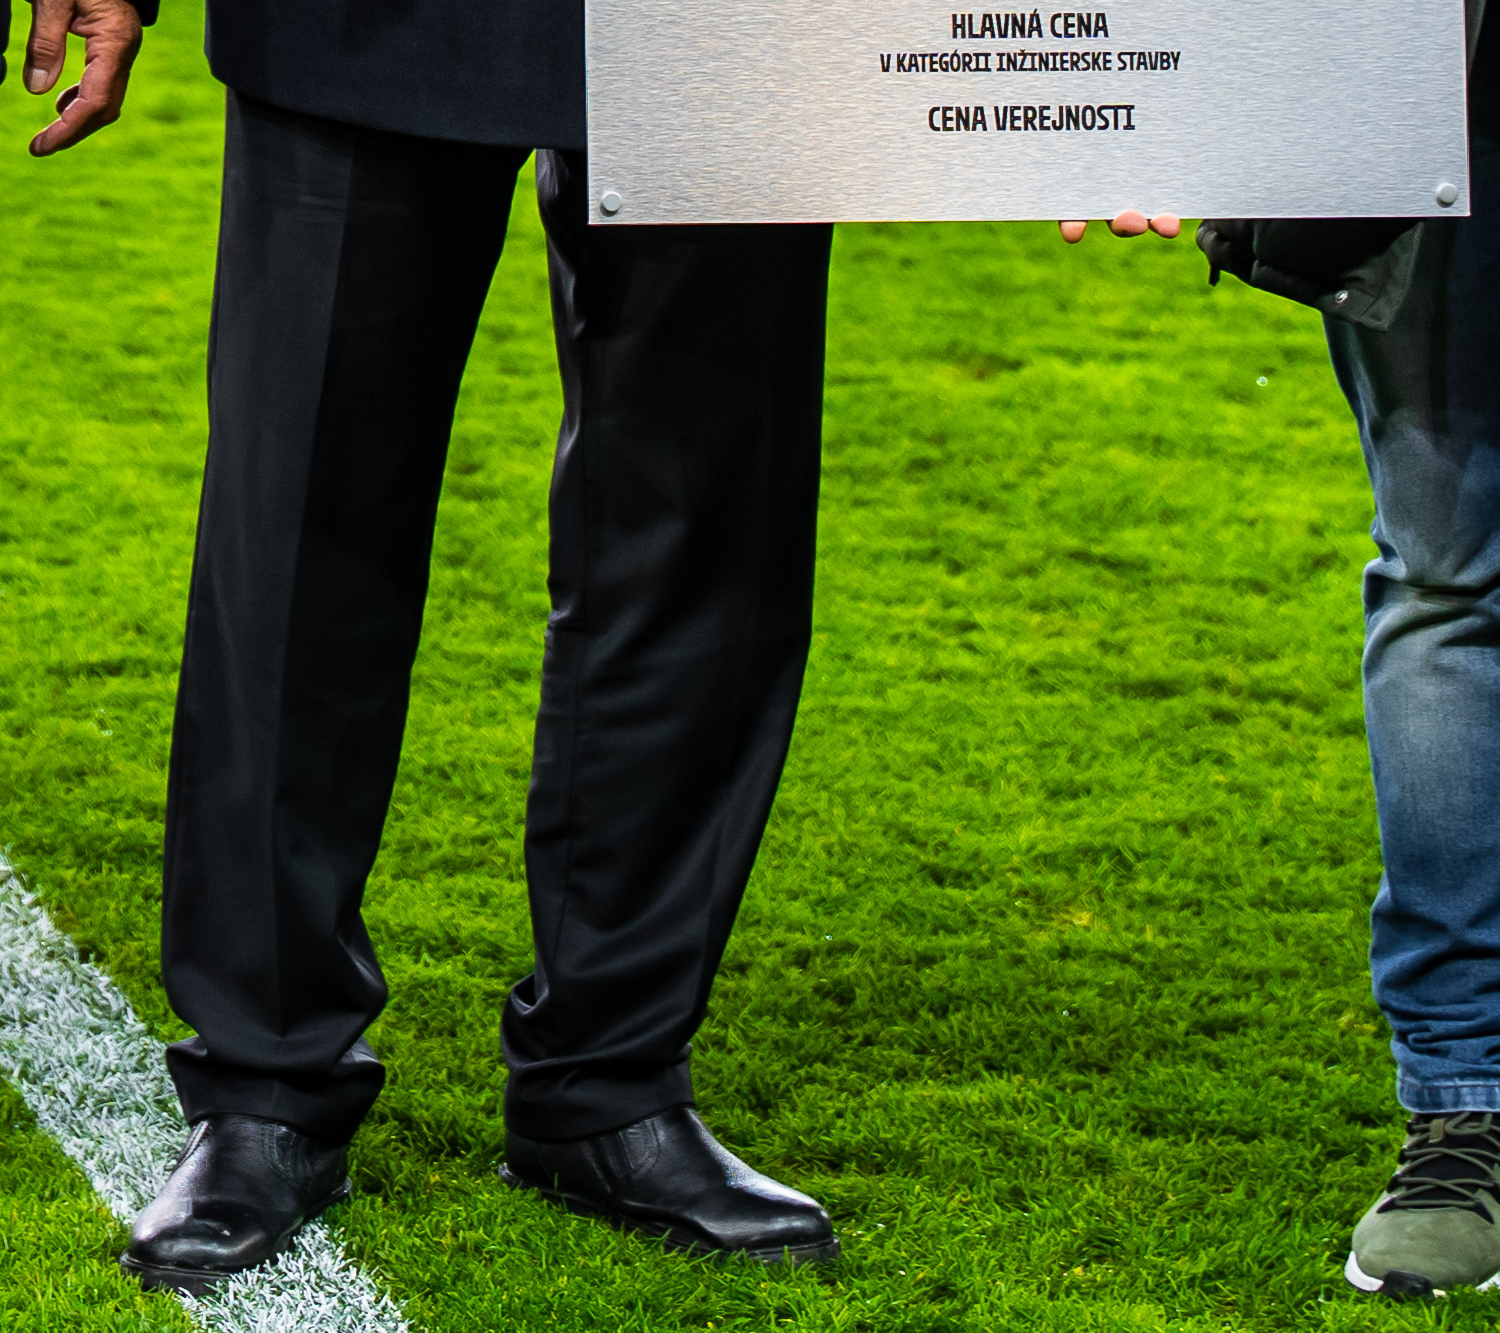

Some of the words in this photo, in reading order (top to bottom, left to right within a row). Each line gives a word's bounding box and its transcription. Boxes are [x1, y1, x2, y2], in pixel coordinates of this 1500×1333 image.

[951, 8, 1044, 40] HLAVNÁ
[1050, 12, 1109, 39] CENA
[879, 53, 892, 73] V
[896, 48, 992, 73] KATEGÓRII
[995, 48, 1113, 72] INŽINIERSKE
[1117, 50, 1182, 72] STAVBY
[928, 105, 988, 132] CENA
[993, 104, 1136, 132] VEREJNOSTI
